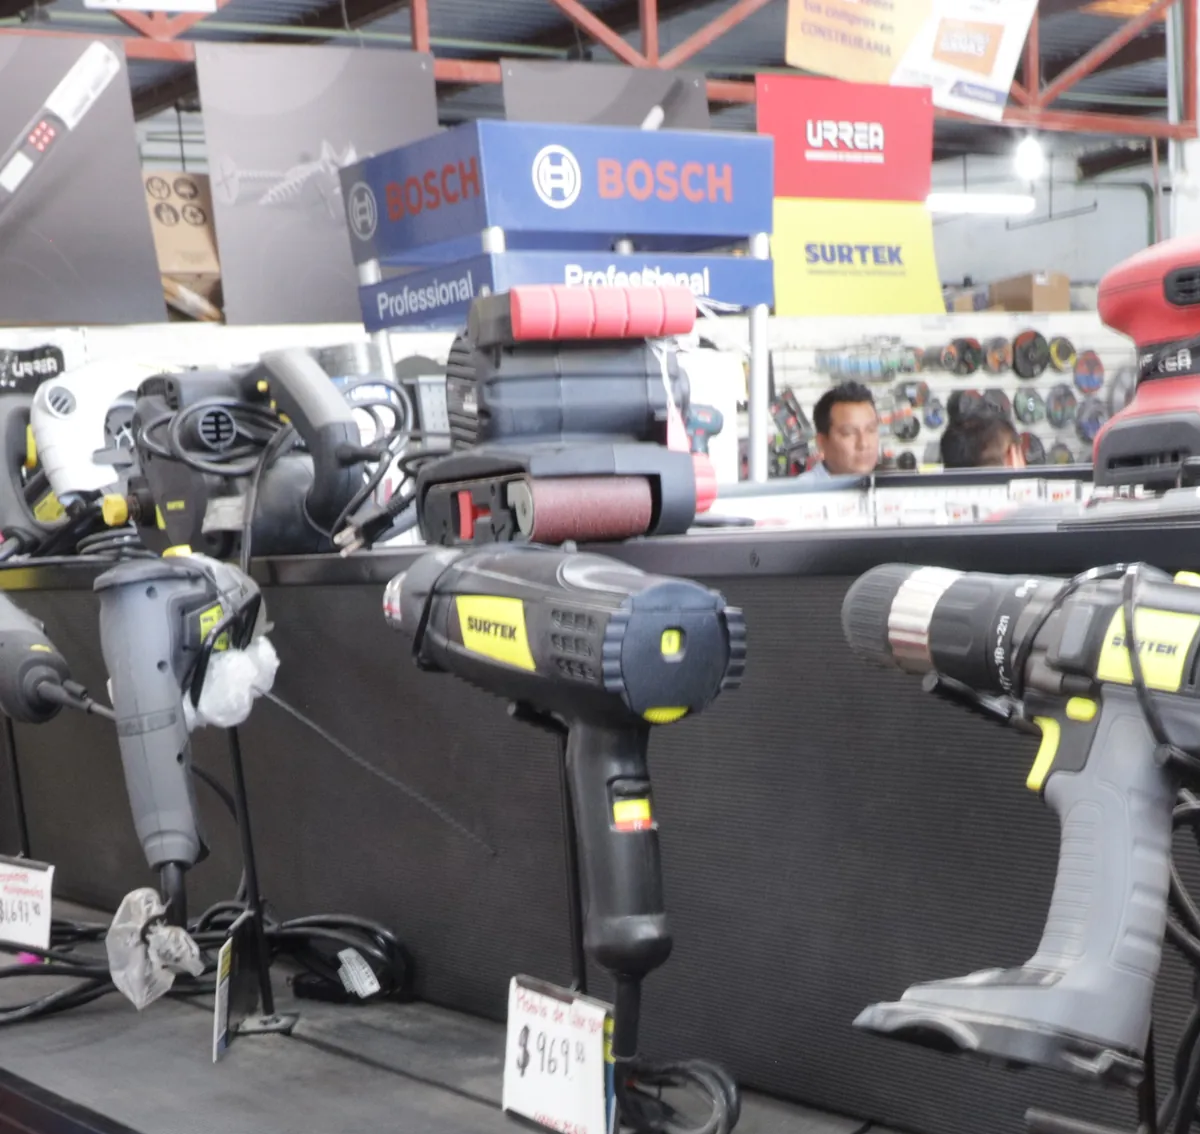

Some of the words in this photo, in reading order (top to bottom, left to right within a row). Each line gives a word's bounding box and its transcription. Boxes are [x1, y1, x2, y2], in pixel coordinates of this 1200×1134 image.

[806, 119, 884, 150] URREA
[385, 155, 480, 222] BOSCH
[597, 158, 734, 203] BOSCH
[804, 243, 904, 266] SURTEK
[376, 270, 474, 321] Professional
[467, 614, 517, 643] SURTEK
